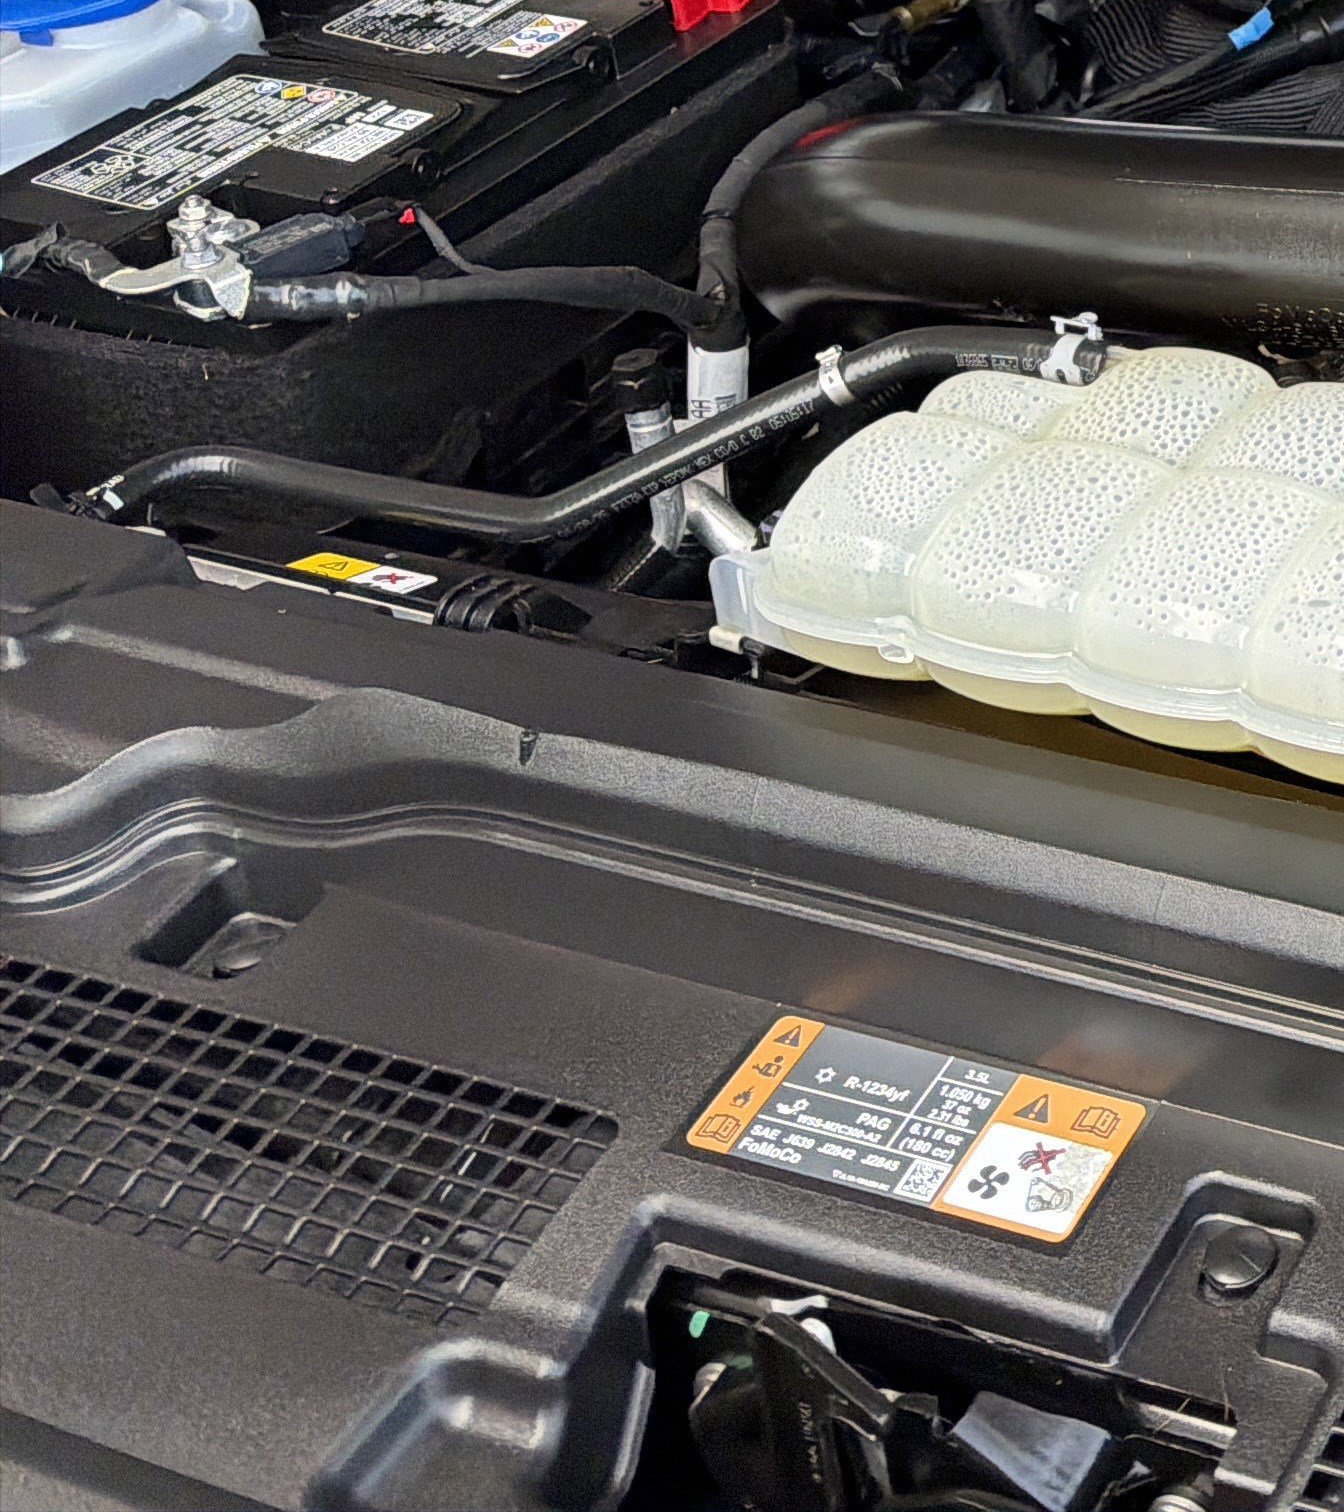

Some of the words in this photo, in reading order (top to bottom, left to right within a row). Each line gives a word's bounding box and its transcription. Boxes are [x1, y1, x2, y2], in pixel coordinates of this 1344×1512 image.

[843, 1075, 910, 1103] R-1234yf
[964, 1068, 991, 1085] 3.5L
[938, 1085, 972, 1103] 1.050
[972, 1091, 992, 1110] kg
[856, 1112, 892, 1130] PAG
[750, 1124, 781, 1141] SAE
[782, 1131, 815, 1150] J639
[738, 1136, 802, 1164] FoMoCo
[930, 1142, 956, 1162] cc)
